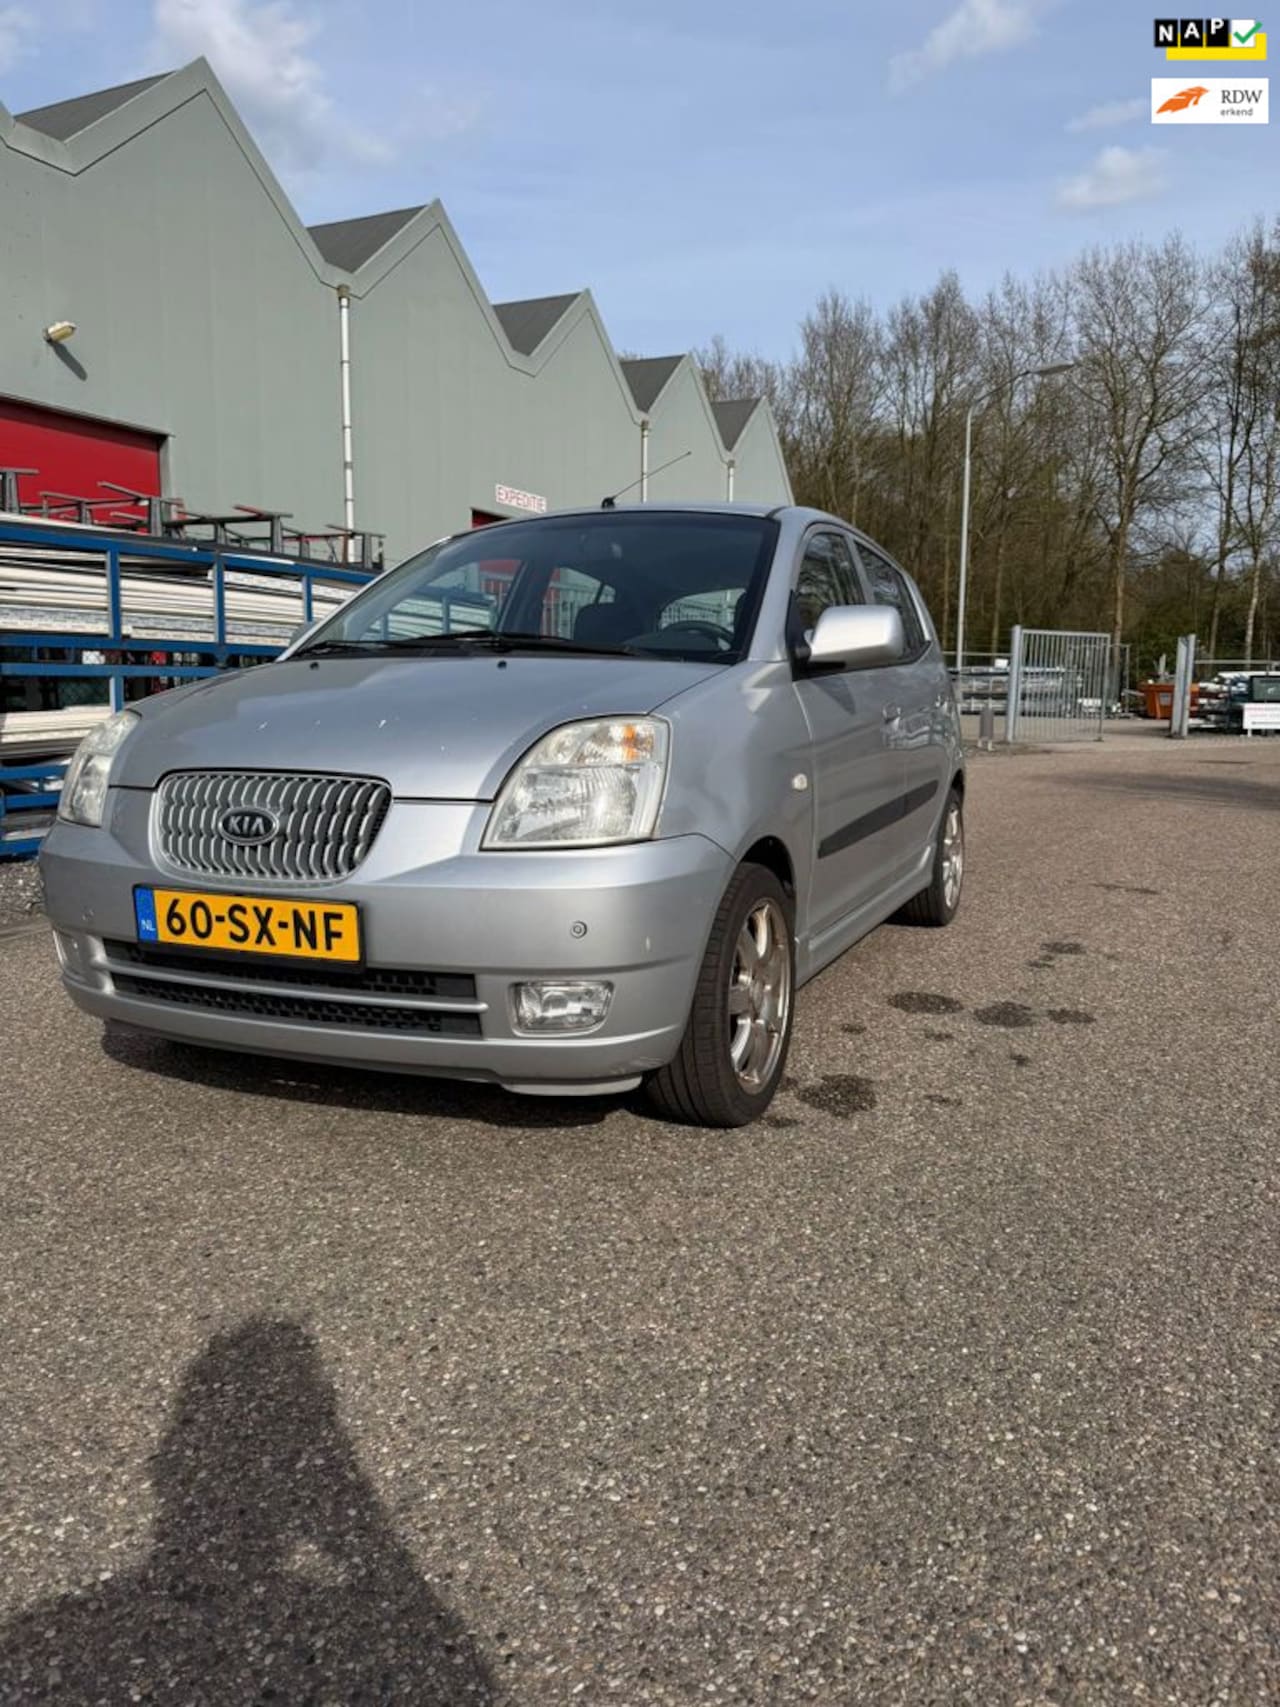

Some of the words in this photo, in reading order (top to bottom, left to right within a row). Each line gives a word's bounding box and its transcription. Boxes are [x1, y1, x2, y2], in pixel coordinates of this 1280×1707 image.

[497, 486, 545, 512] EXPEDITIE
[227, 815, 265, 834] KIA
[140, 918, 156, 931] NL
[166, 898, 344, 951] 60-SX-NF
